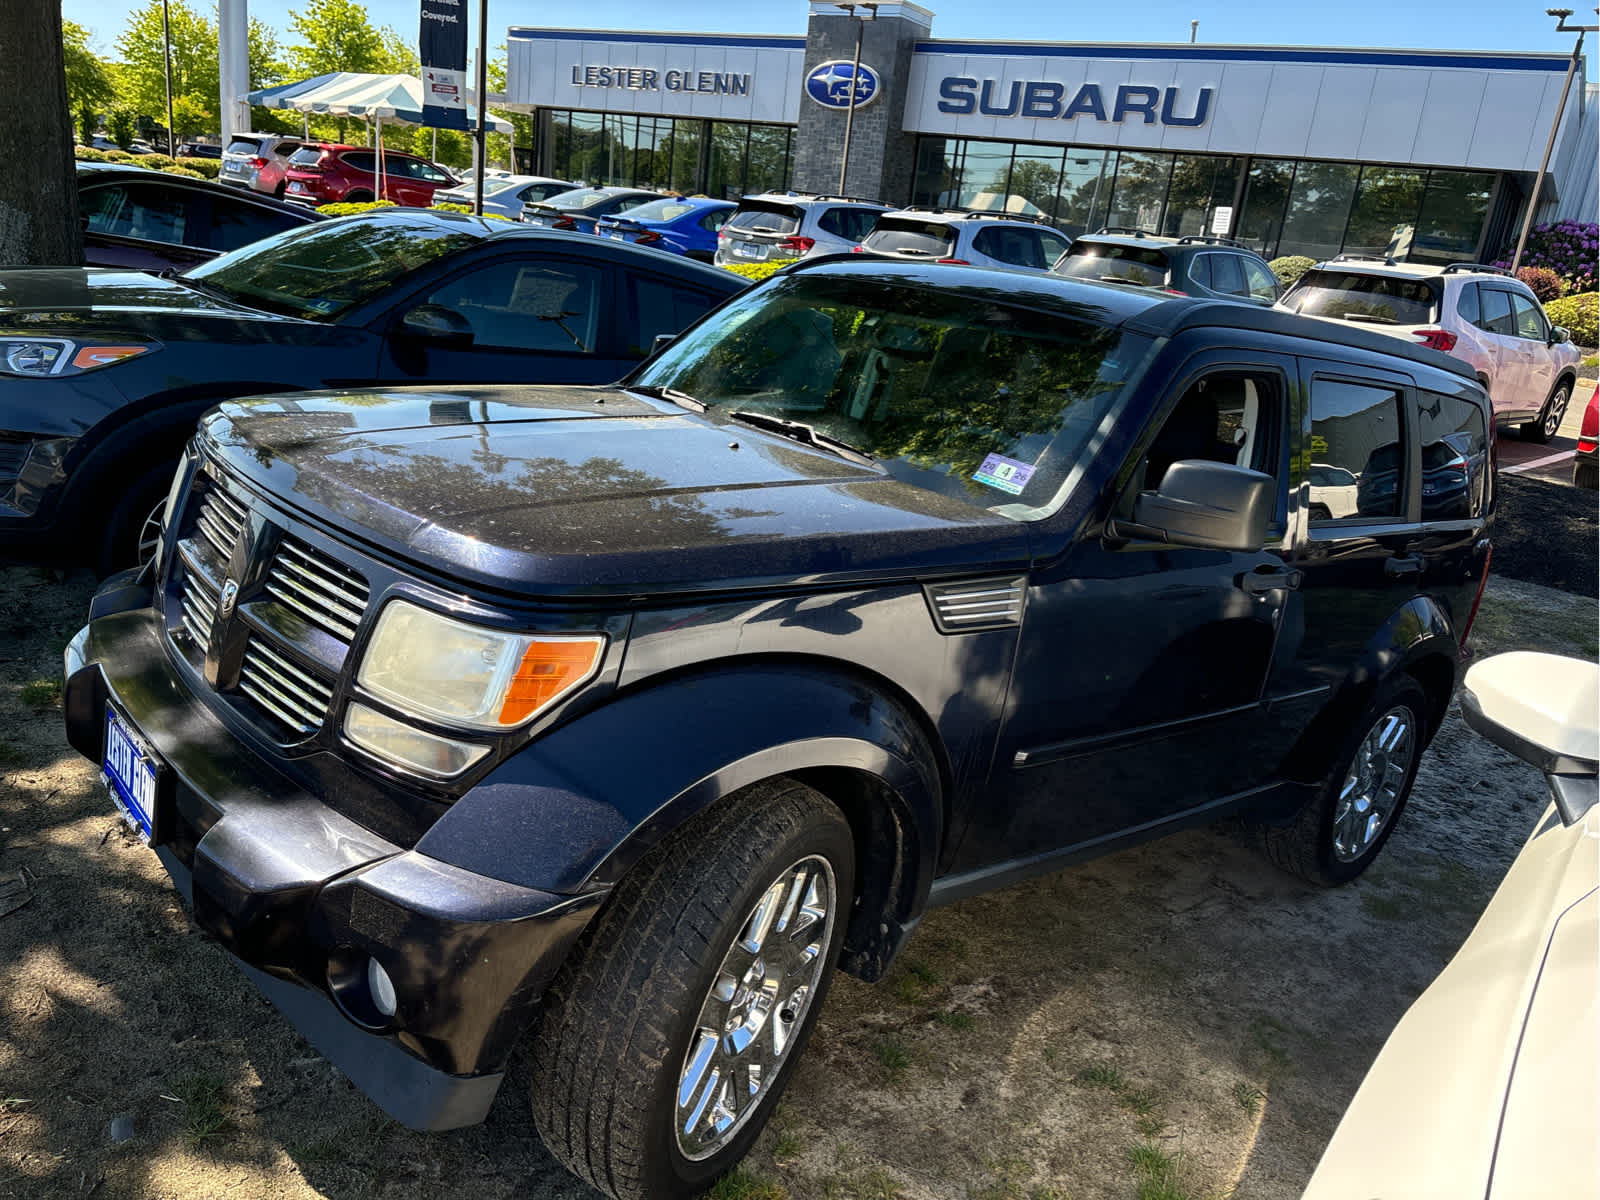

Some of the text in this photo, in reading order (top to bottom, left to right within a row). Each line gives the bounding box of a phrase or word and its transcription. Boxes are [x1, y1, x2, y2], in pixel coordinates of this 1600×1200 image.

[421, 10, 459, 24] Covered.
[571, 65, 750, 96] LESTER GLENN
[937, 76, 1213, 128] SUBARU
[107, 720, 132, 790] LESTER
[133, 755, 156, 822] GLENN
